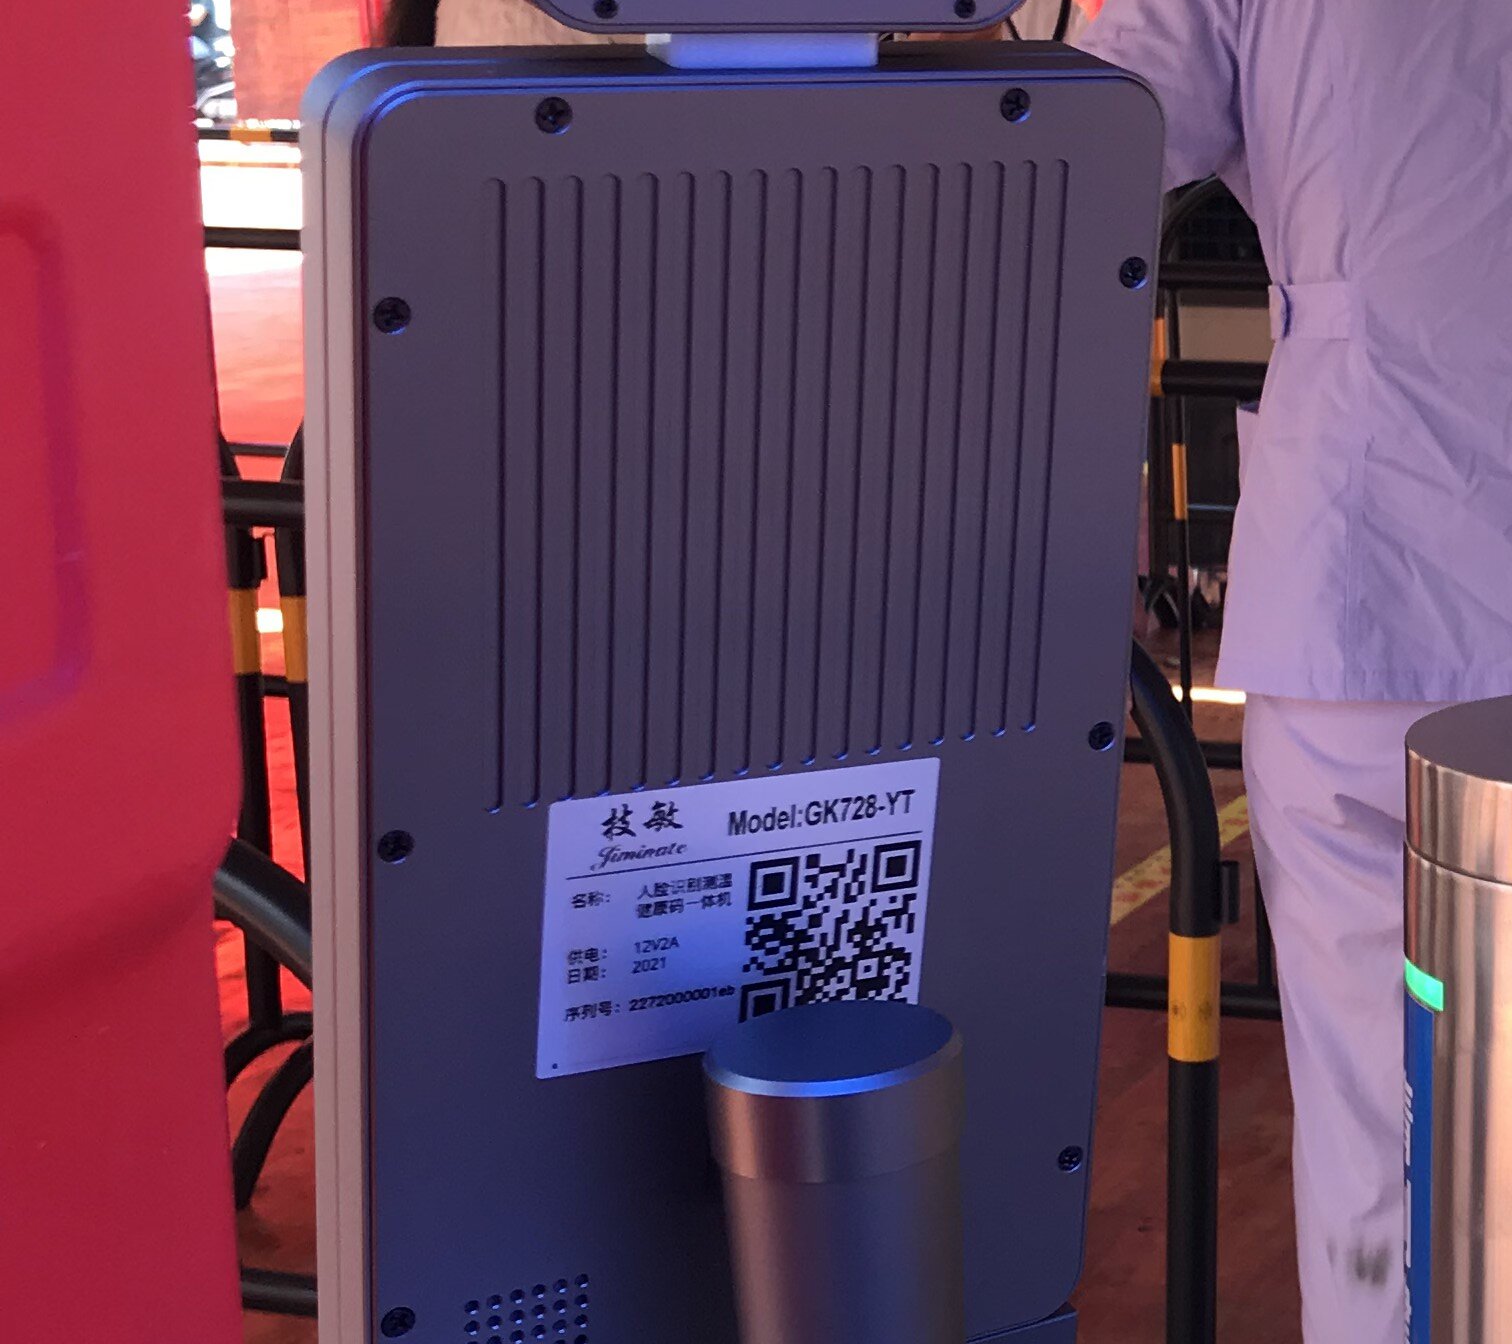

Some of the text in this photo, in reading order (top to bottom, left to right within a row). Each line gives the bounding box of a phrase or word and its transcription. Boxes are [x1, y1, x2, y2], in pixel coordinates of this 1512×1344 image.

[727, 788, 916, 836] Model:GK728-YT
[637, 872, 733, 900] 人脸识别测温
[635, 892, 732, 919] 健康码一体机
[634, 936, 680, 954] 12V2A
[632, 957, 667, 975] 2021
